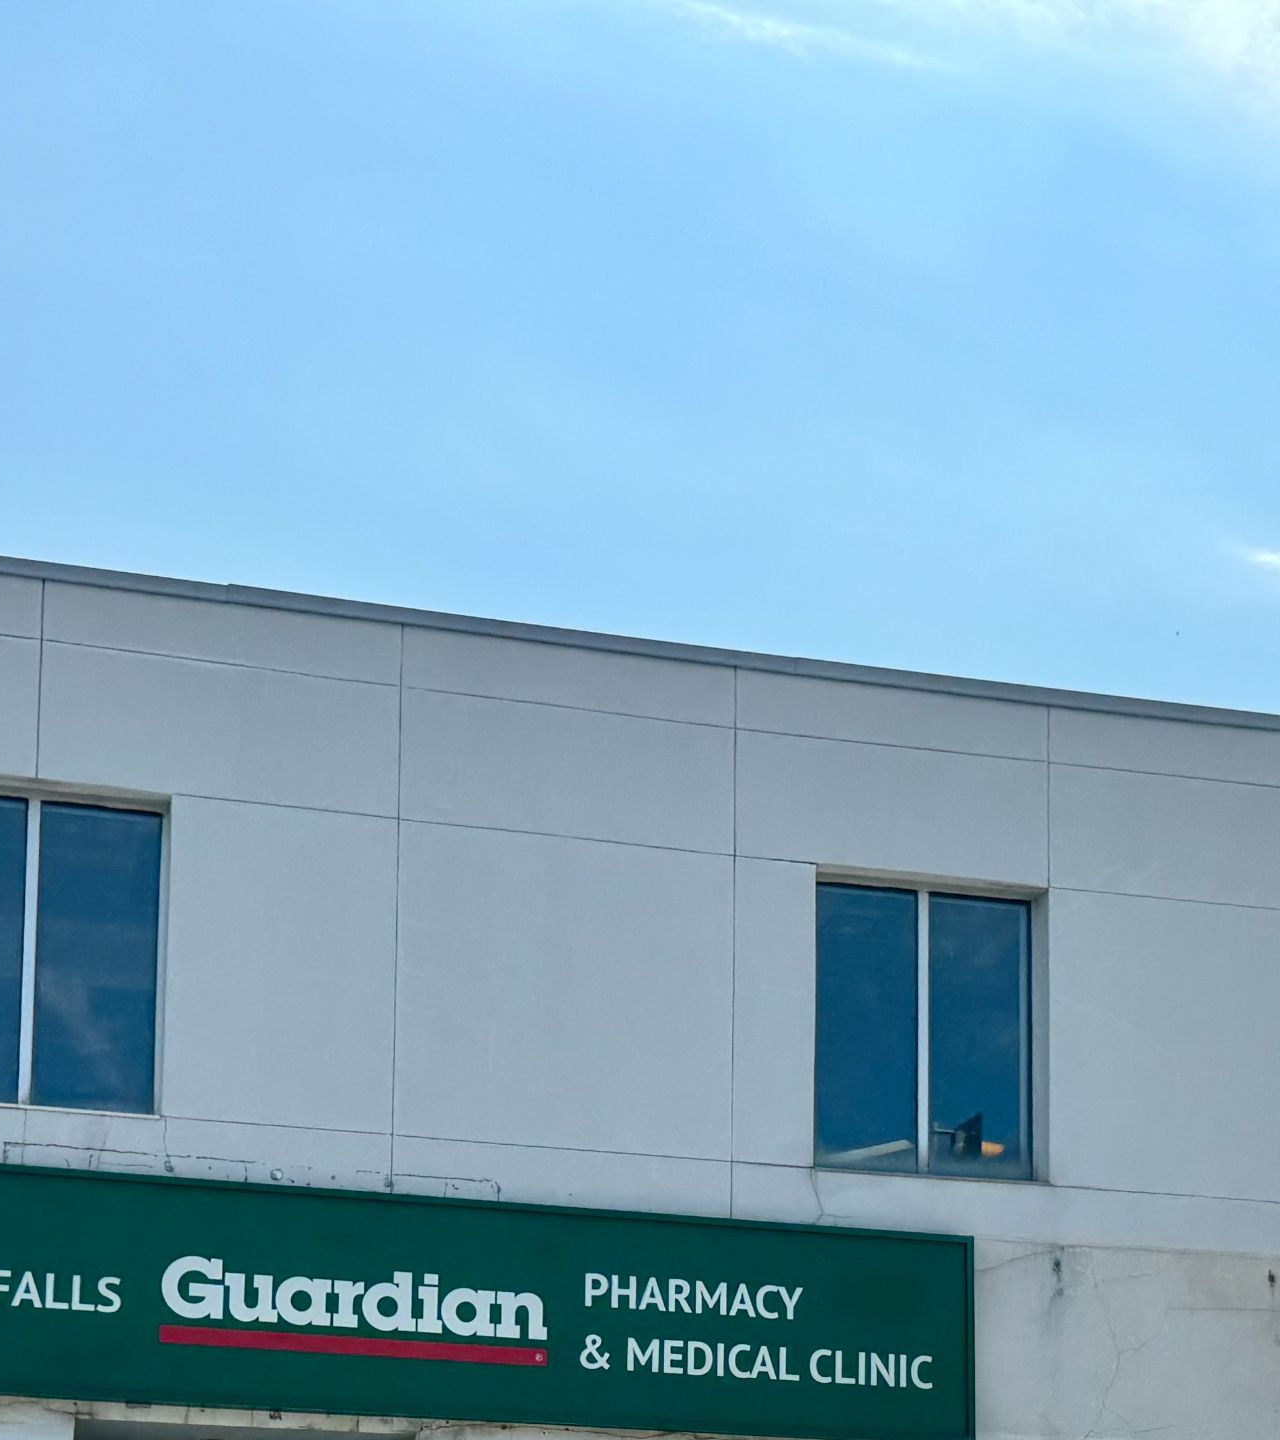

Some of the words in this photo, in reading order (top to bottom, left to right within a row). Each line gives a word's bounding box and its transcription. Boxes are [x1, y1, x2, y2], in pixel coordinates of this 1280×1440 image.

[161, 1255, 548, 1341] Guardian
[584, 1272, 804, 1320] PHARMACY
[579, 1334, 611, 1370] &
[626, 1337, 801, 1382] MEDICAL
[809, 1348, 934, 1390] CLINIC
